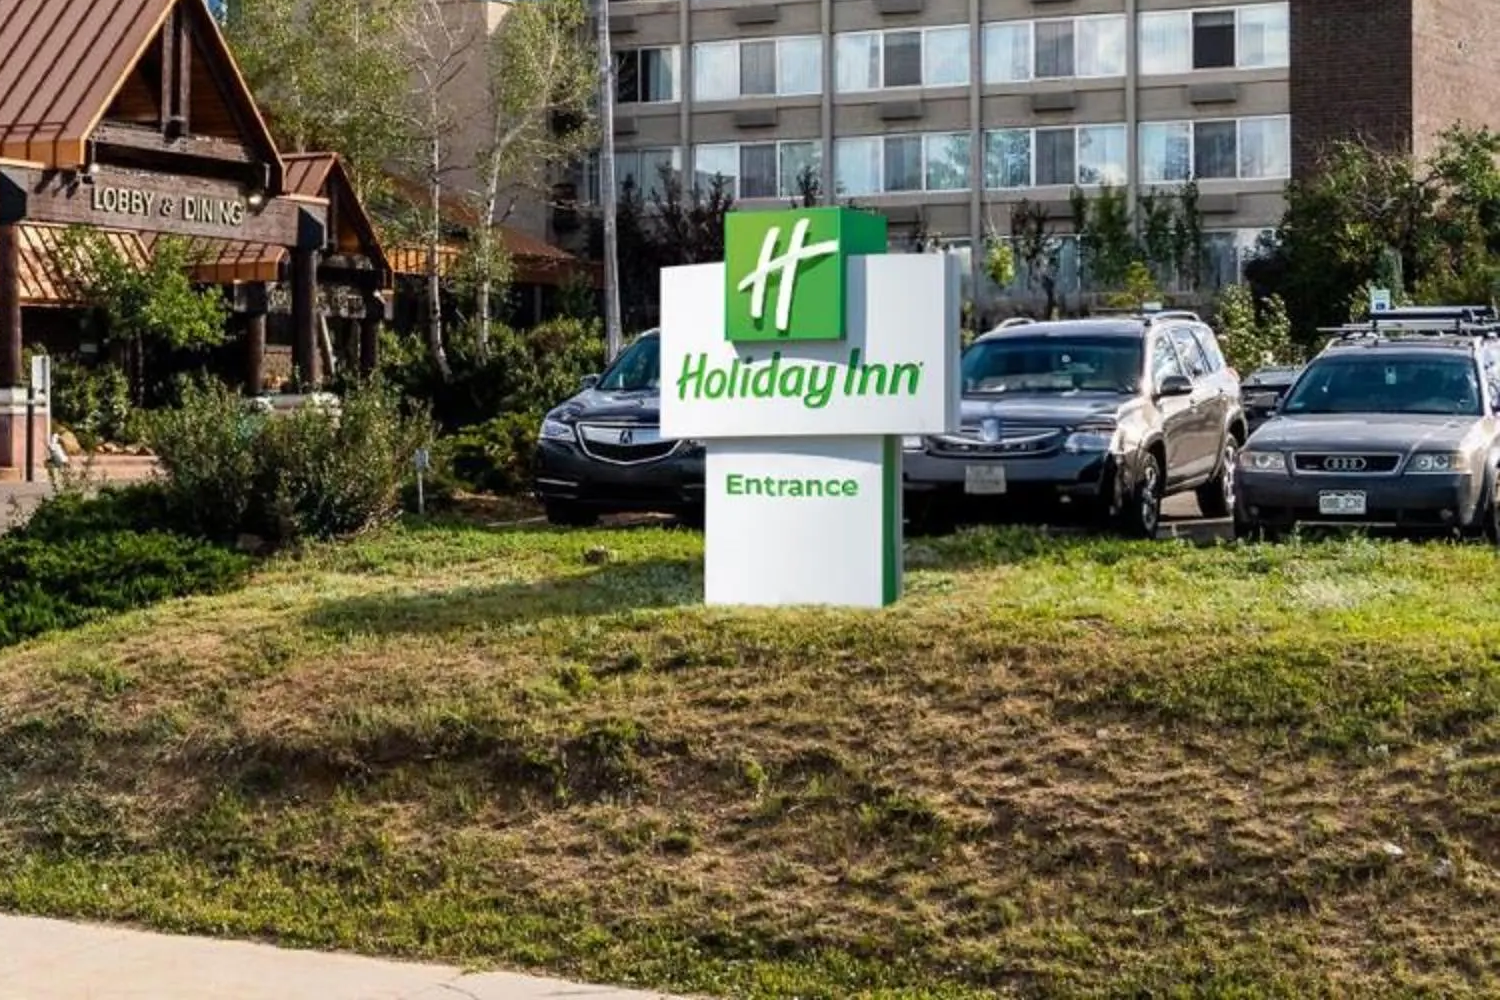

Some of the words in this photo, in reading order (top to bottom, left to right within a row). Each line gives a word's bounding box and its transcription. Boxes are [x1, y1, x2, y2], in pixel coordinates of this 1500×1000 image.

[92, 186, 153, 215] LOBBY
[161, 198, 174, 216] &
[738, 218, 839, 330] H
[677, 351, 836, 408] Holiday
[844, 348, 922, 396] Inn
[726, 474, 859, 497] Entrance
